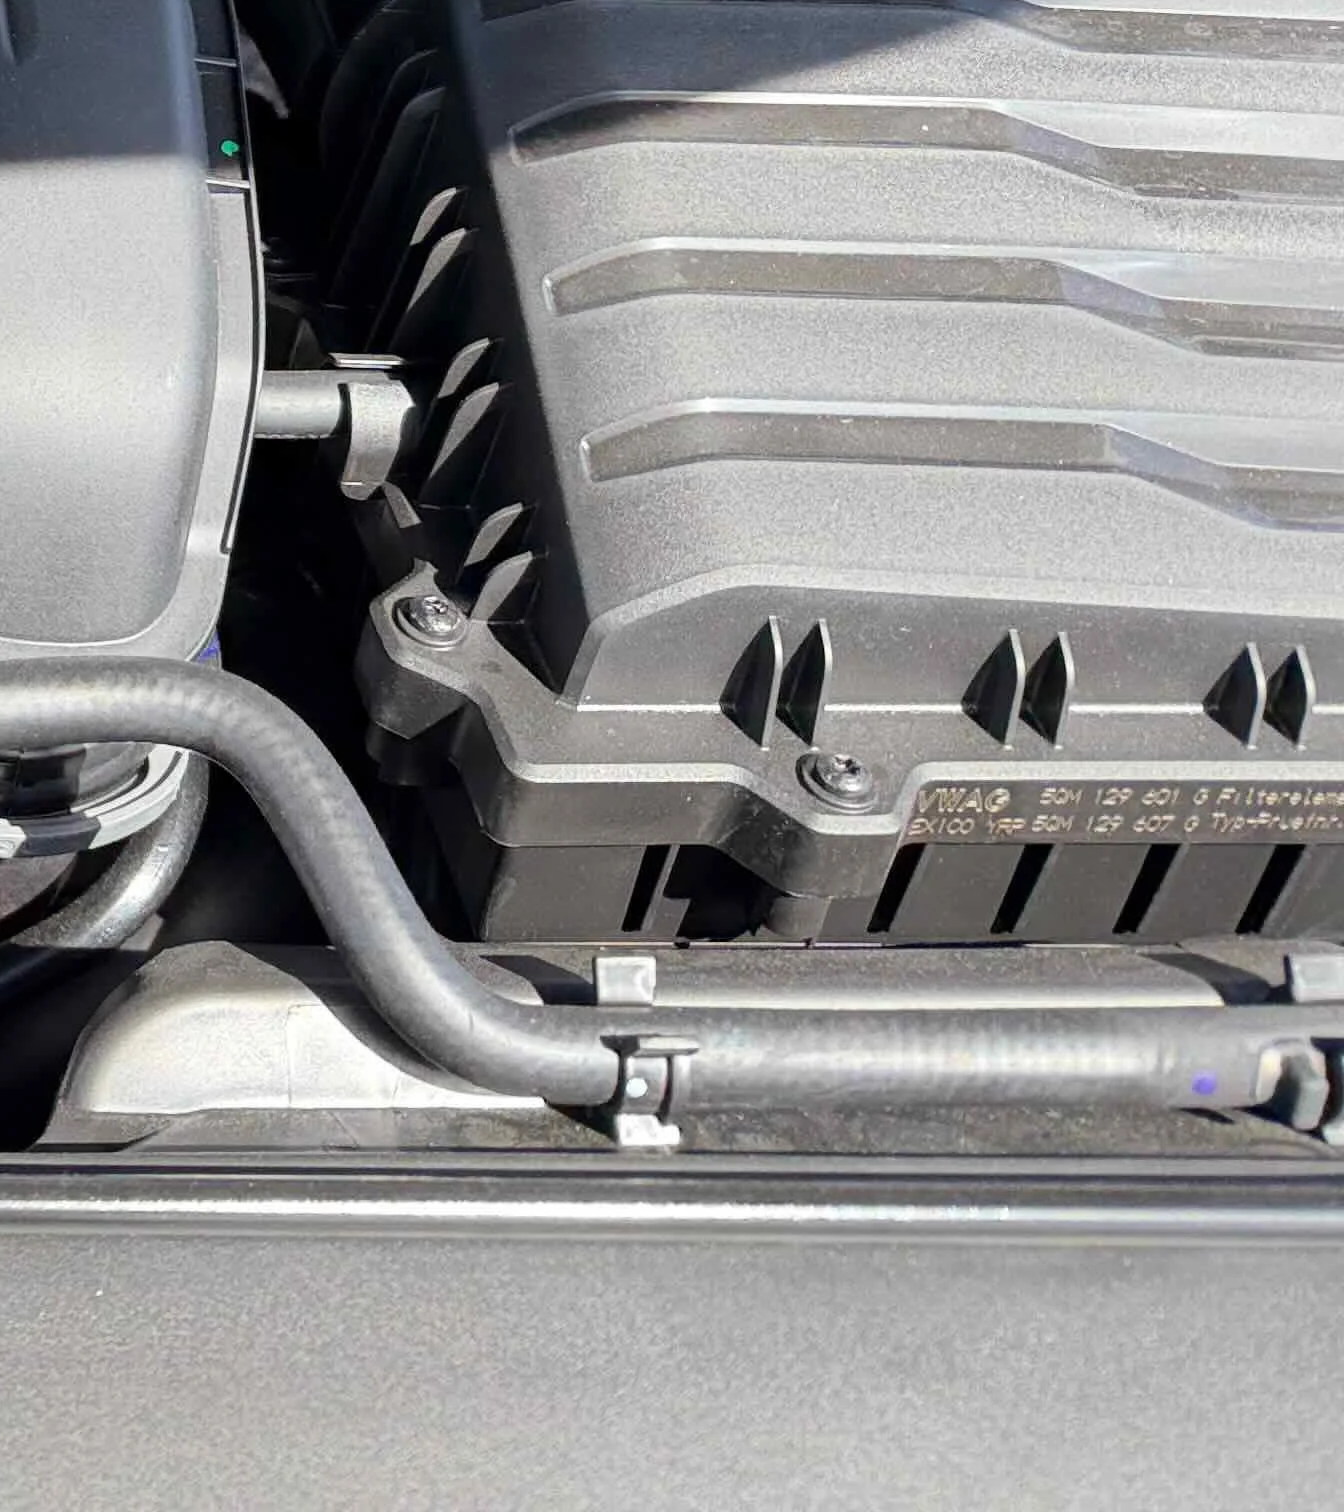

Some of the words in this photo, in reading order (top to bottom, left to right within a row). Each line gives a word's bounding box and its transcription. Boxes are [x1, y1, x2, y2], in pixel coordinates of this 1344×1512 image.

[917, 787, 1011, 813] VWAG
[1095, 787, 1133, 806] 129
[1140, 788, 1182, 806] 601
[1086, 814, 1124, 833] 129
[1132, 814, 1175, 833] 607
